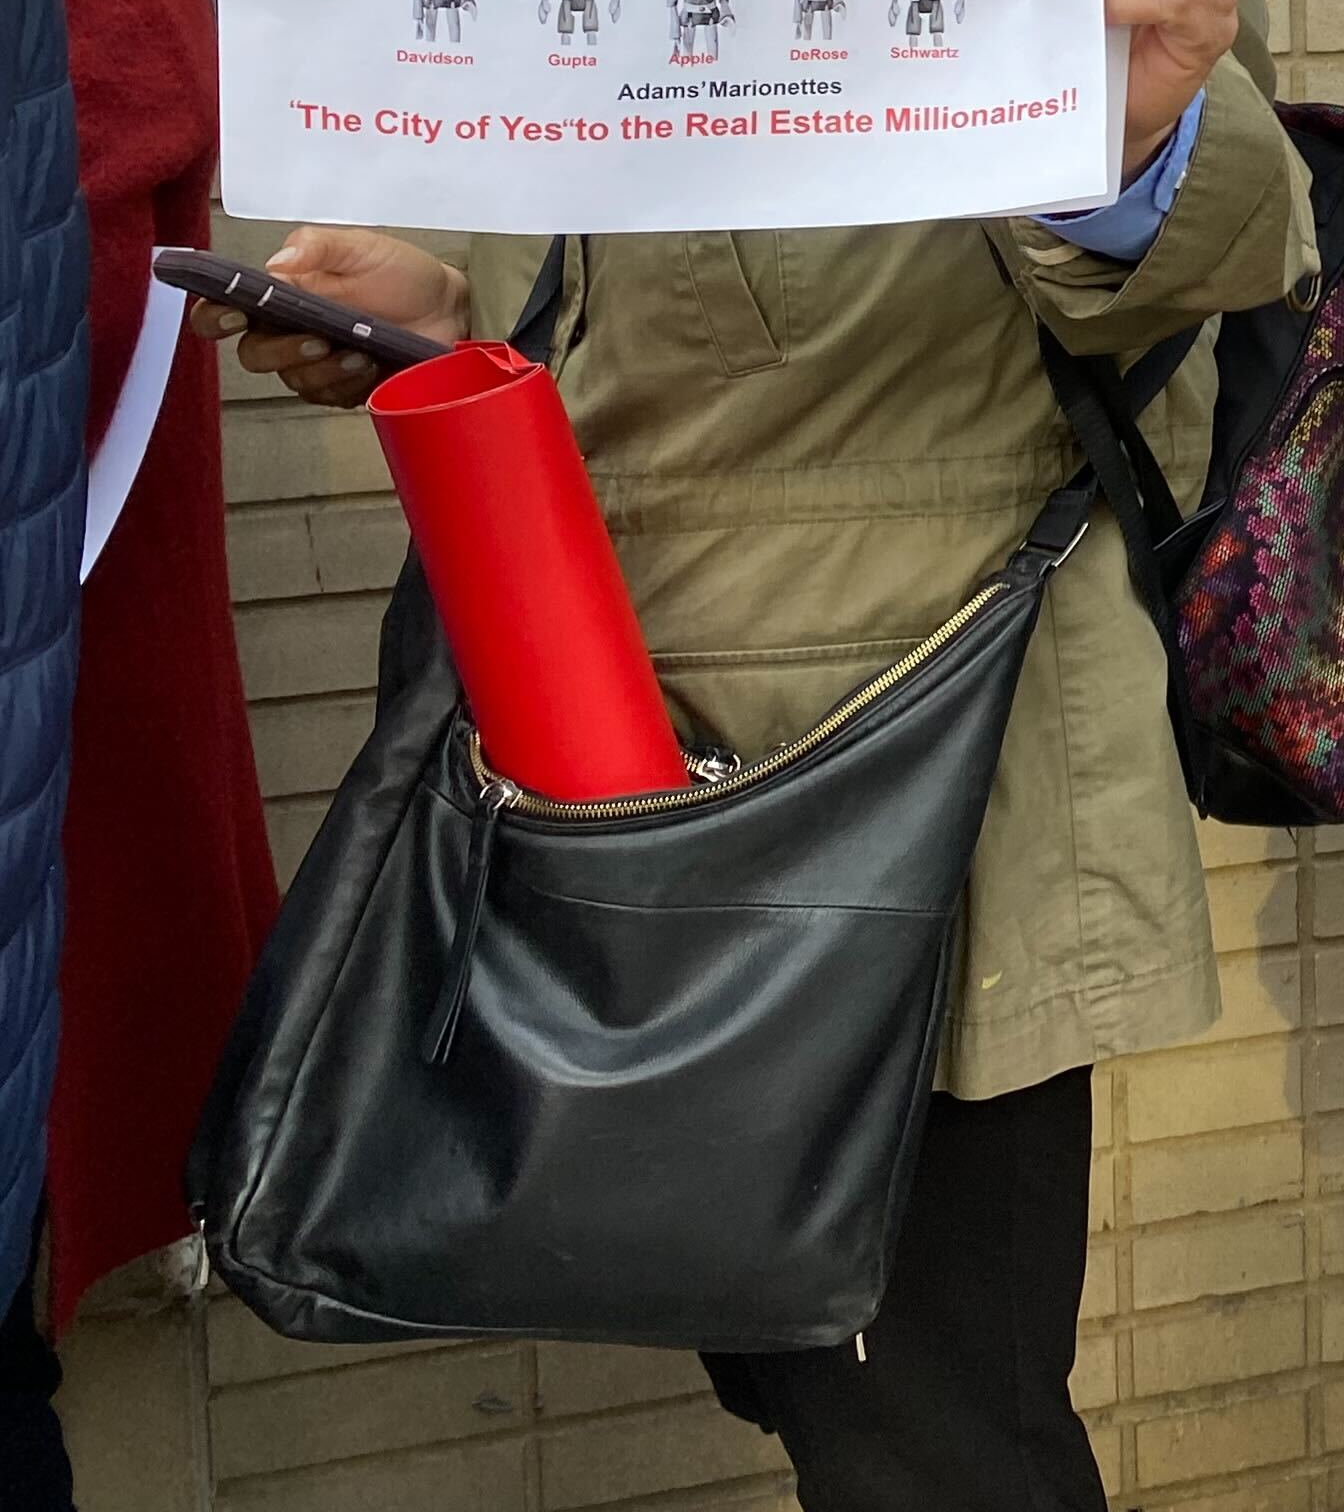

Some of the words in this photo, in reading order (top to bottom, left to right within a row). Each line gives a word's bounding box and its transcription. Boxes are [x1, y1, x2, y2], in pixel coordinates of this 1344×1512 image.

[396, 49, 475, 66] Davidson
[548, 53, 598, 70] Gupta
[668, 52, 715, 67] Apple
[789, 48, 849, 62] DeRose
[889, 46, 959, 60] Schwartz
[709, 78, 843, 99] Marionettes
[374, 109, 444, 144] City
[455, 115, 491, 140] of
[620, 115, 674, 139] the
[686, 110, 758, 138] Real
[770, 109, 874, 135] Estate
[884, 88, 1078, 133] Millionaires!!
